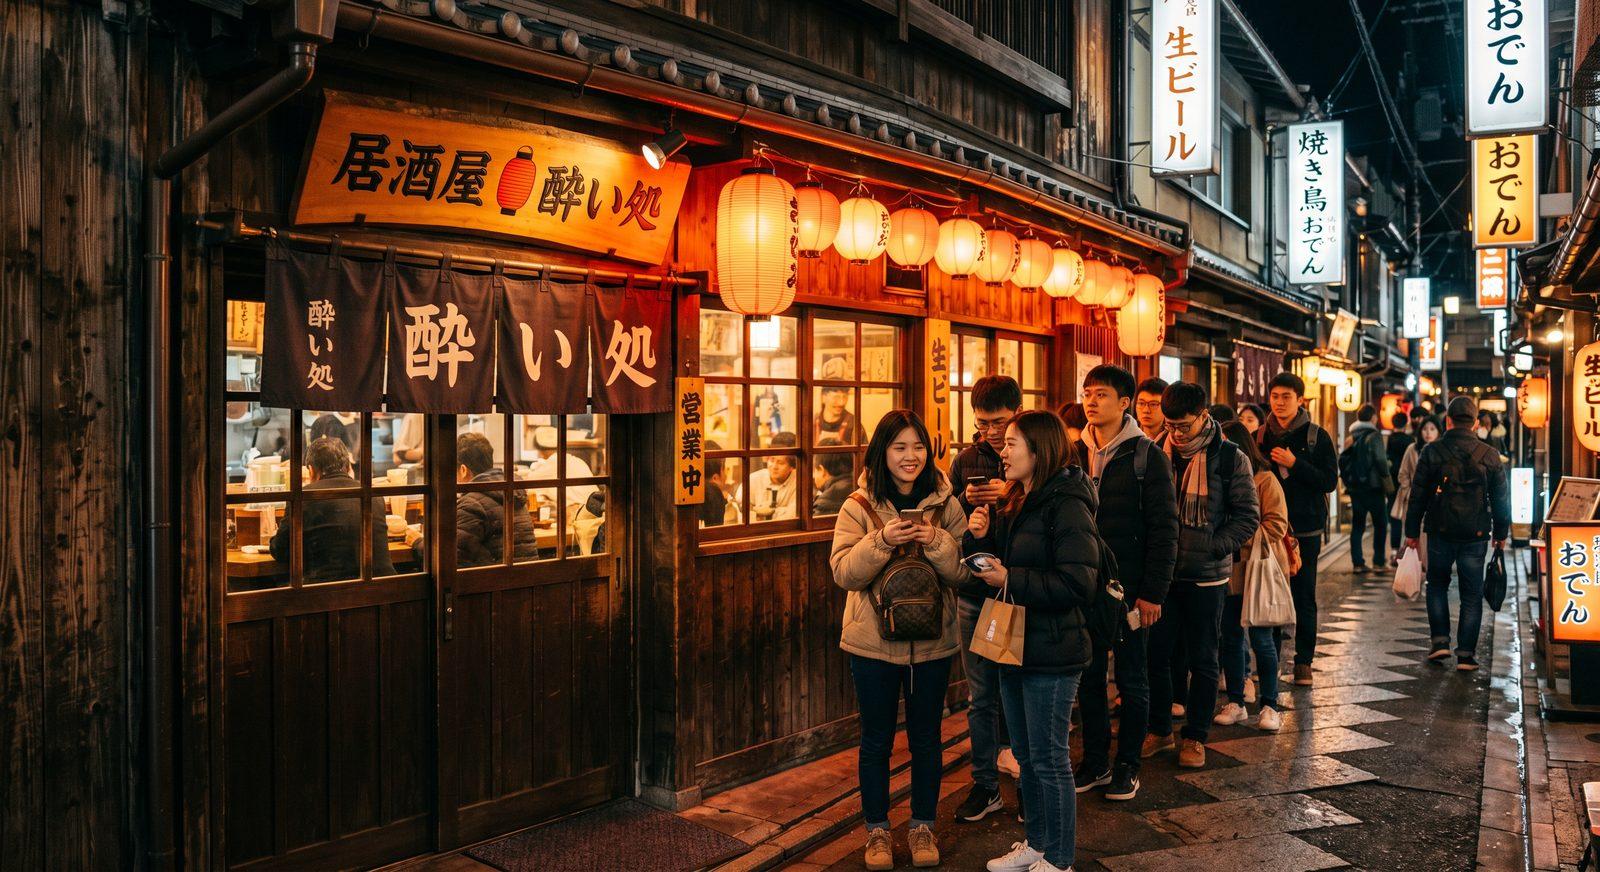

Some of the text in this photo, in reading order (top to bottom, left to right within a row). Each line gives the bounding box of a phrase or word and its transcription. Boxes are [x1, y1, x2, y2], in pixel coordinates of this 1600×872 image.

[1164, 25, 1198, 162] 生ビール
[1487, 0, 1525, 105] おでん
[331, 132, 663, 231] 居酒屋 酔い処
[1298, 130, 1329, 275] 焼き鳥おでん
[1489, 141, 1523, 236] おでん
[307, 299, 336, 391] 酔い処
[404, 301, 657, 389] 酔い処
[681, 392, 702, 496] 営業中
[931, 337, 946, 460] 生ビール
[1559, 541, 1590, 624] おでん
